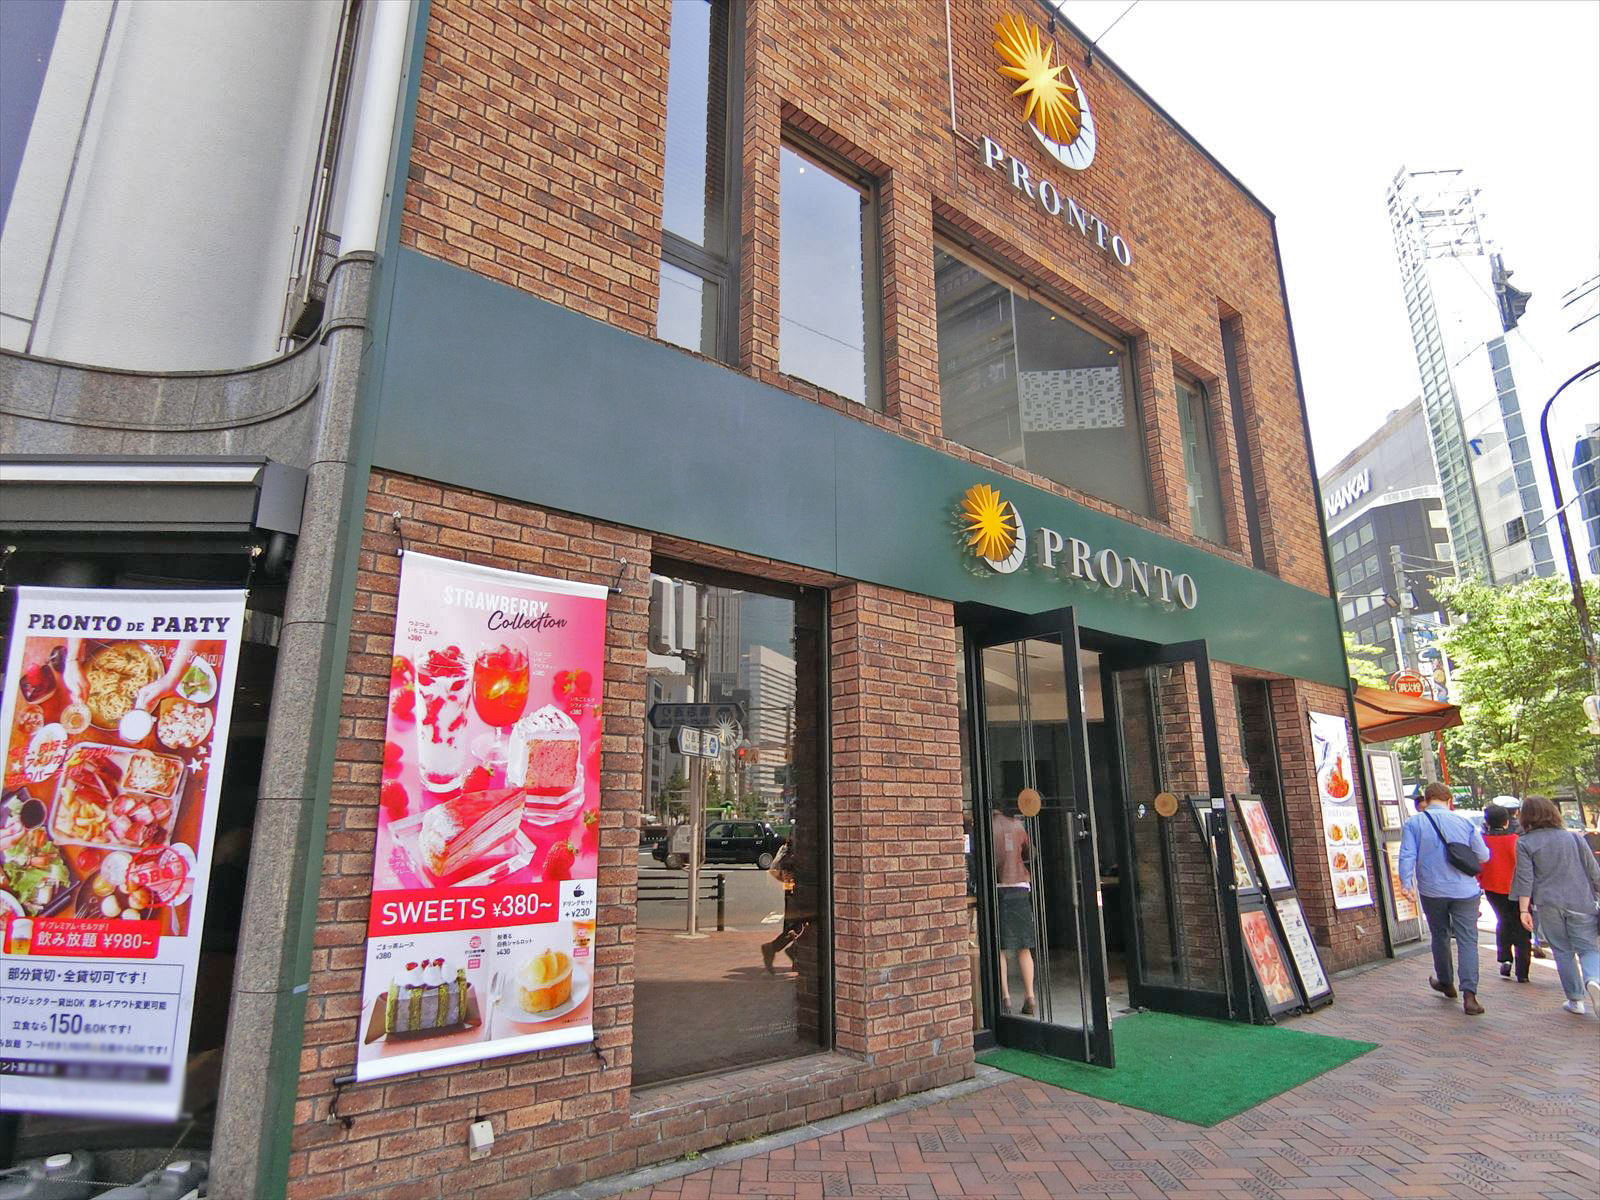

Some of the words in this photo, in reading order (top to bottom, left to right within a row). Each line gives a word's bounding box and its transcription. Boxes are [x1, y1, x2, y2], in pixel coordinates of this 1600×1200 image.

[981, 134, 1132, 267] PRONTO
[1325, 468, 1369, 520] NANKAI
[1040, 527, 1198, 610] PRONTO
[443, 586, 549, 617] STRAWBERRY
[27, 613, 122, 632] PRONTO
[126, 622, 144, 631] DE
[151, 616, 230, 633] PARTY
[487, 610, 568, 633] Collection
[382, 897, 486, 925] SWEETS
[493, 893, 553, 917] ¥380~
[37, 931, 97, 948] 飲み放題
